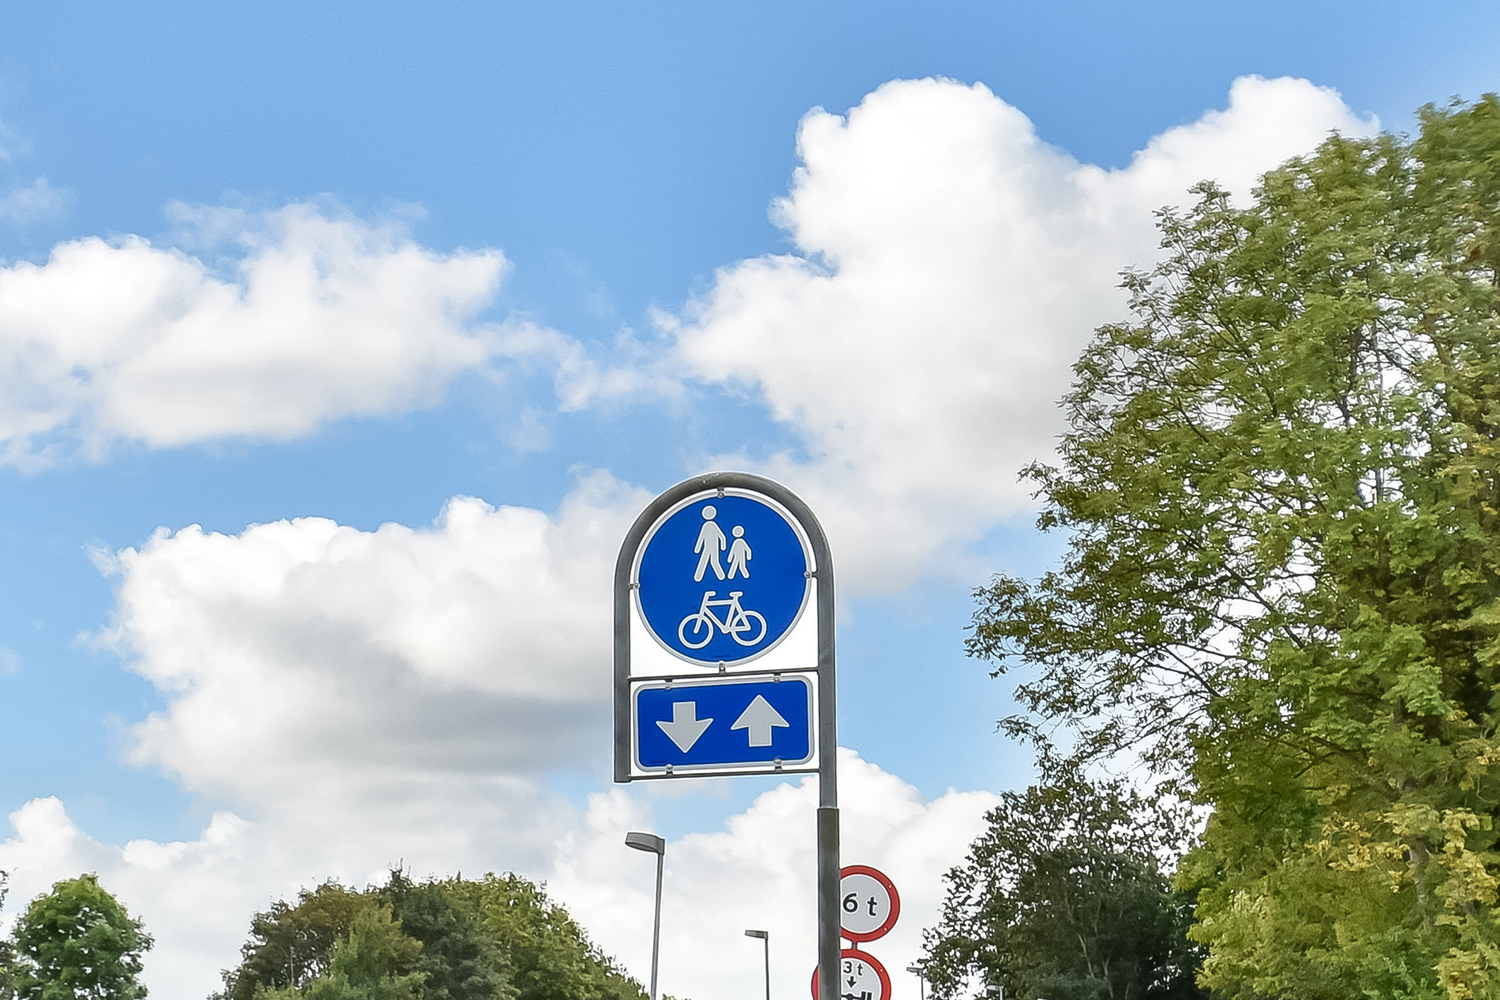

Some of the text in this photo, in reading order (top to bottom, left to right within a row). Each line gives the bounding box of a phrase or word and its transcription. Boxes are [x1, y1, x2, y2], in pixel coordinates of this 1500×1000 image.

[842, 892, 878, 916] 6 t
[843, 961, 863, 976] 3 t
